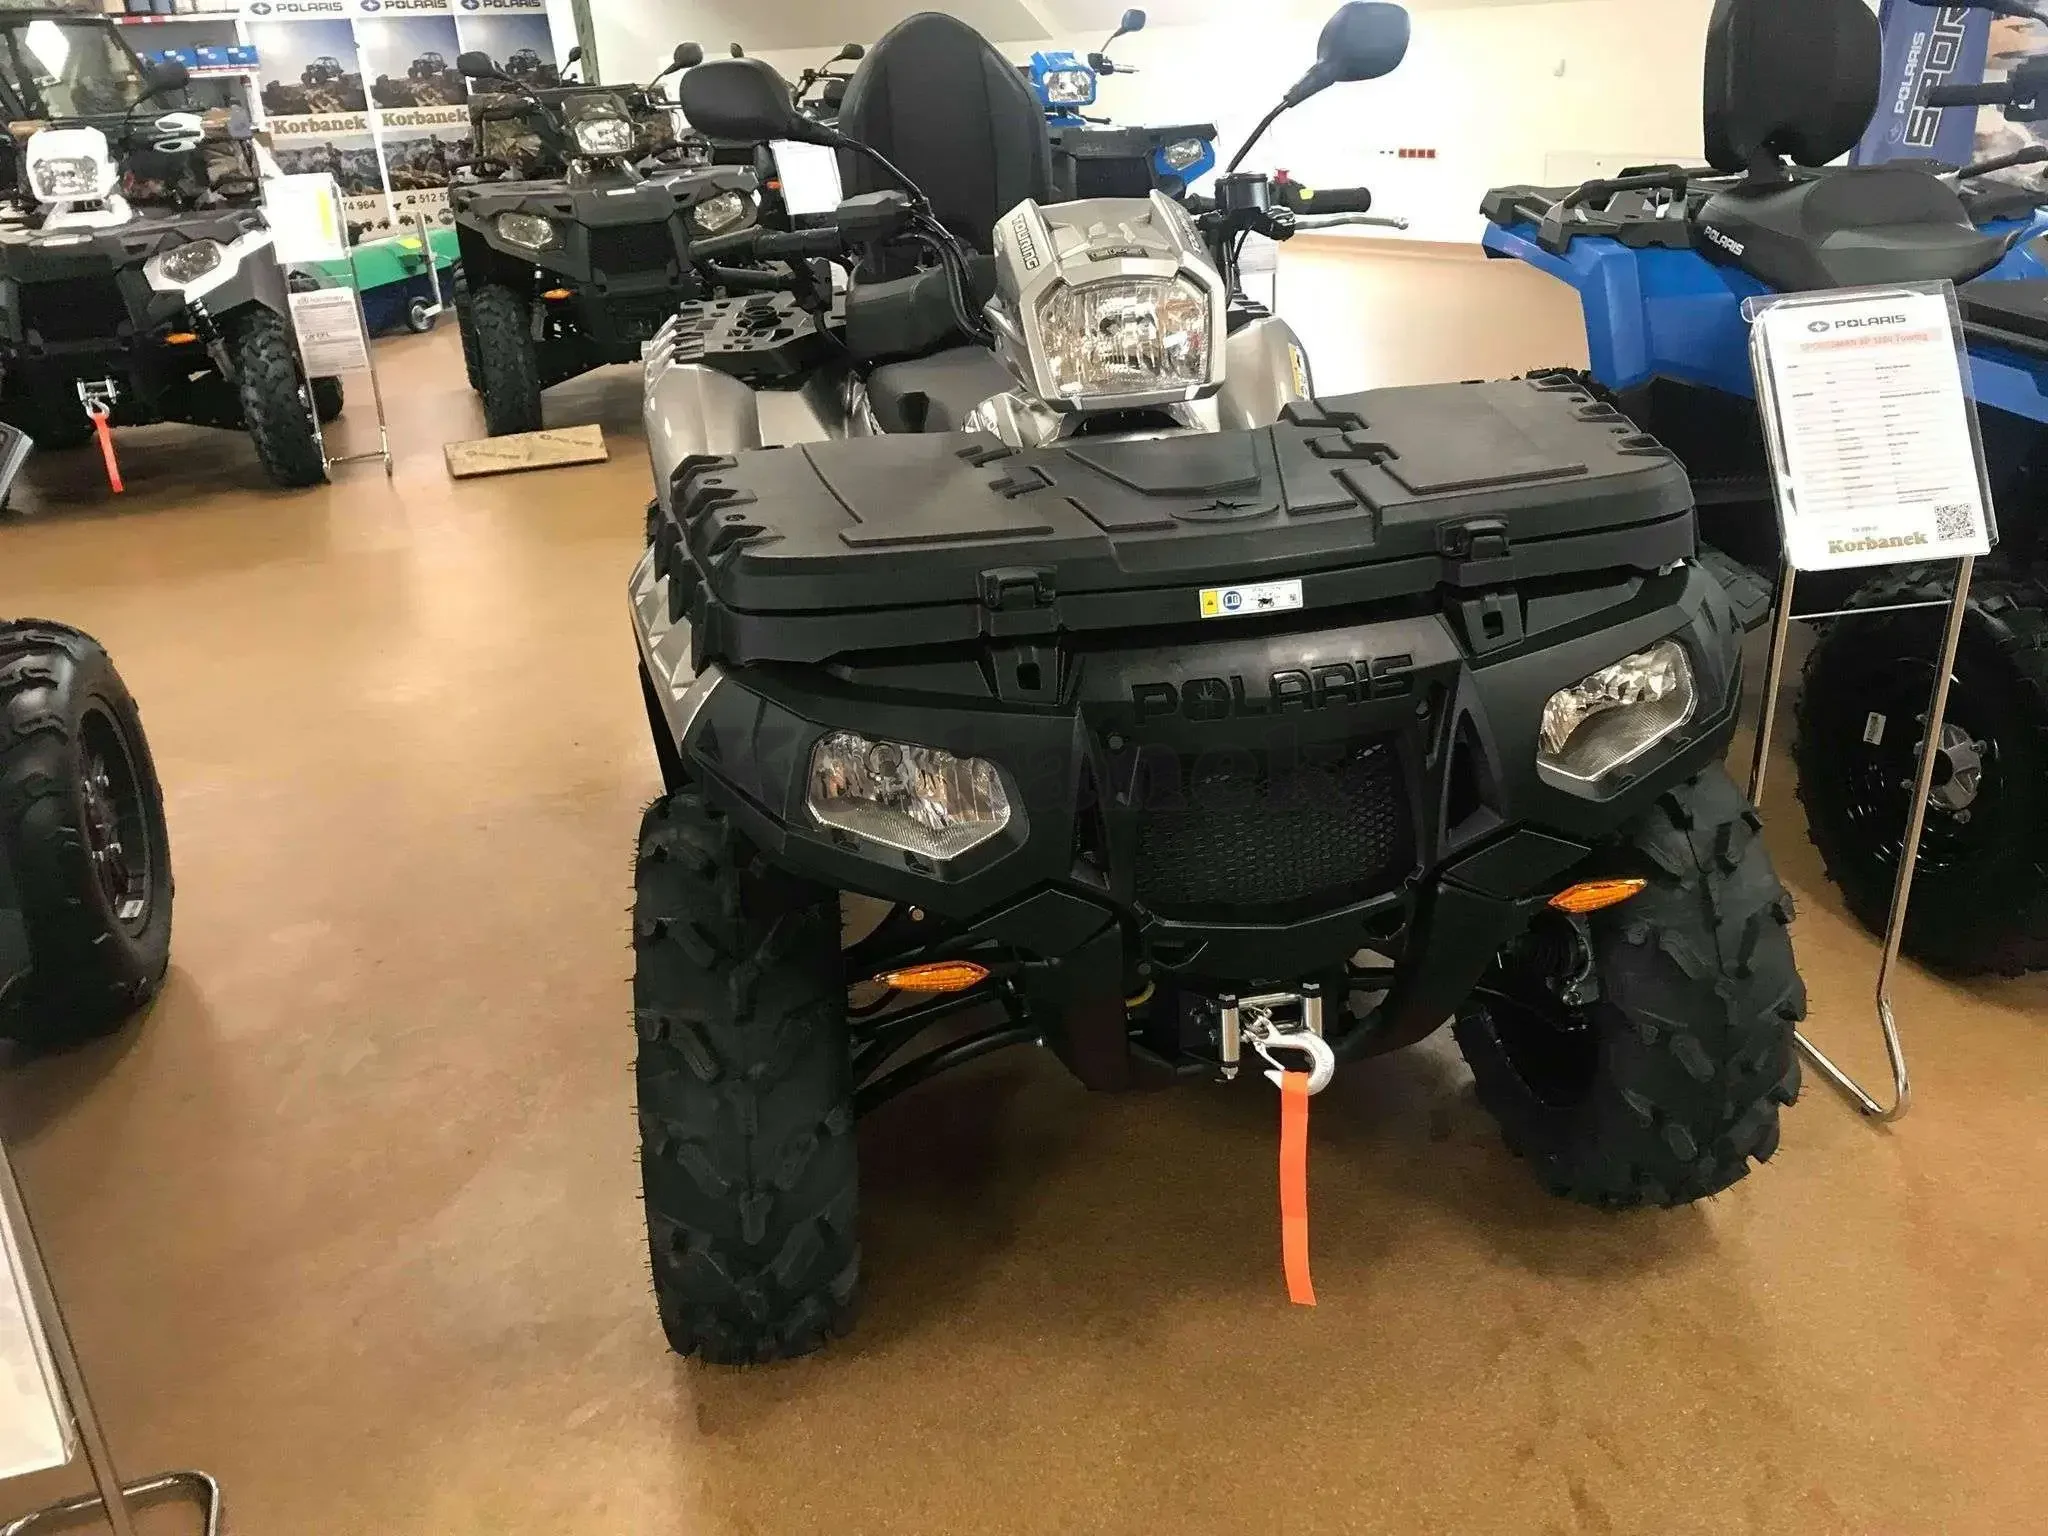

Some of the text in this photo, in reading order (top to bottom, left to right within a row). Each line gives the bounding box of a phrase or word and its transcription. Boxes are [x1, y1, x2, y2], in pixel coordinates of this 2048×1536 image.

[276, 2, 343, 13] POLARIS
[384, 0, 448, 9] POLARIS
[483, 0, 541, 8] POLARIS
[1894, 31, 1926, 114] POLARIS
[274, 115, 367, 135] Korbanek
[382, 109, 469, 126] Korbanek
[356, 199, 376, 211] 964
[419, 193, 436, 204] 512
[1012, 213, 1040, 270] TOURING
[1704, 225, 1745, 256] POLARIS
[1835, 314, 1907, 329] POLARIS
[1828, 531, 1928, 554] Korbanek
[1131, 654, 1415, 727] POLARIS
